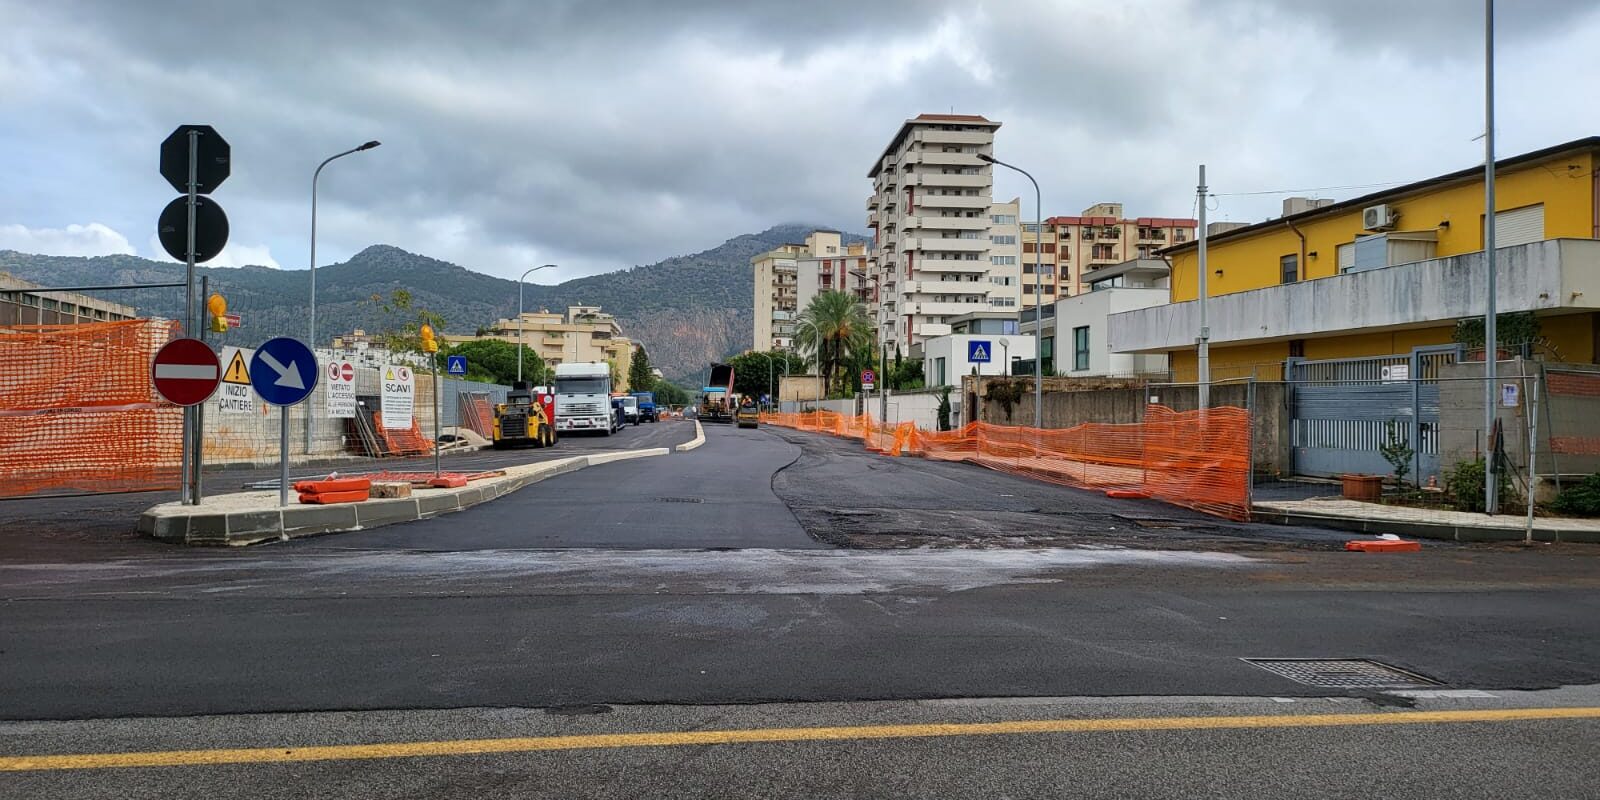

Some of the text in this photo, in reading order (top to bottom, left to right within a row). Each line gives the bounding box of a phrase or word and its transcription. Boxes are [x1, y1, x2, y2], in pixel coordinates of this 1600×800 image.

[225, 384, 247, 397] INIZIO
[331, 383, 351, 391] VIETATO
[385, 383, 411, 393] SCAVI
[220, 398, 252, 411] CANTIERE
